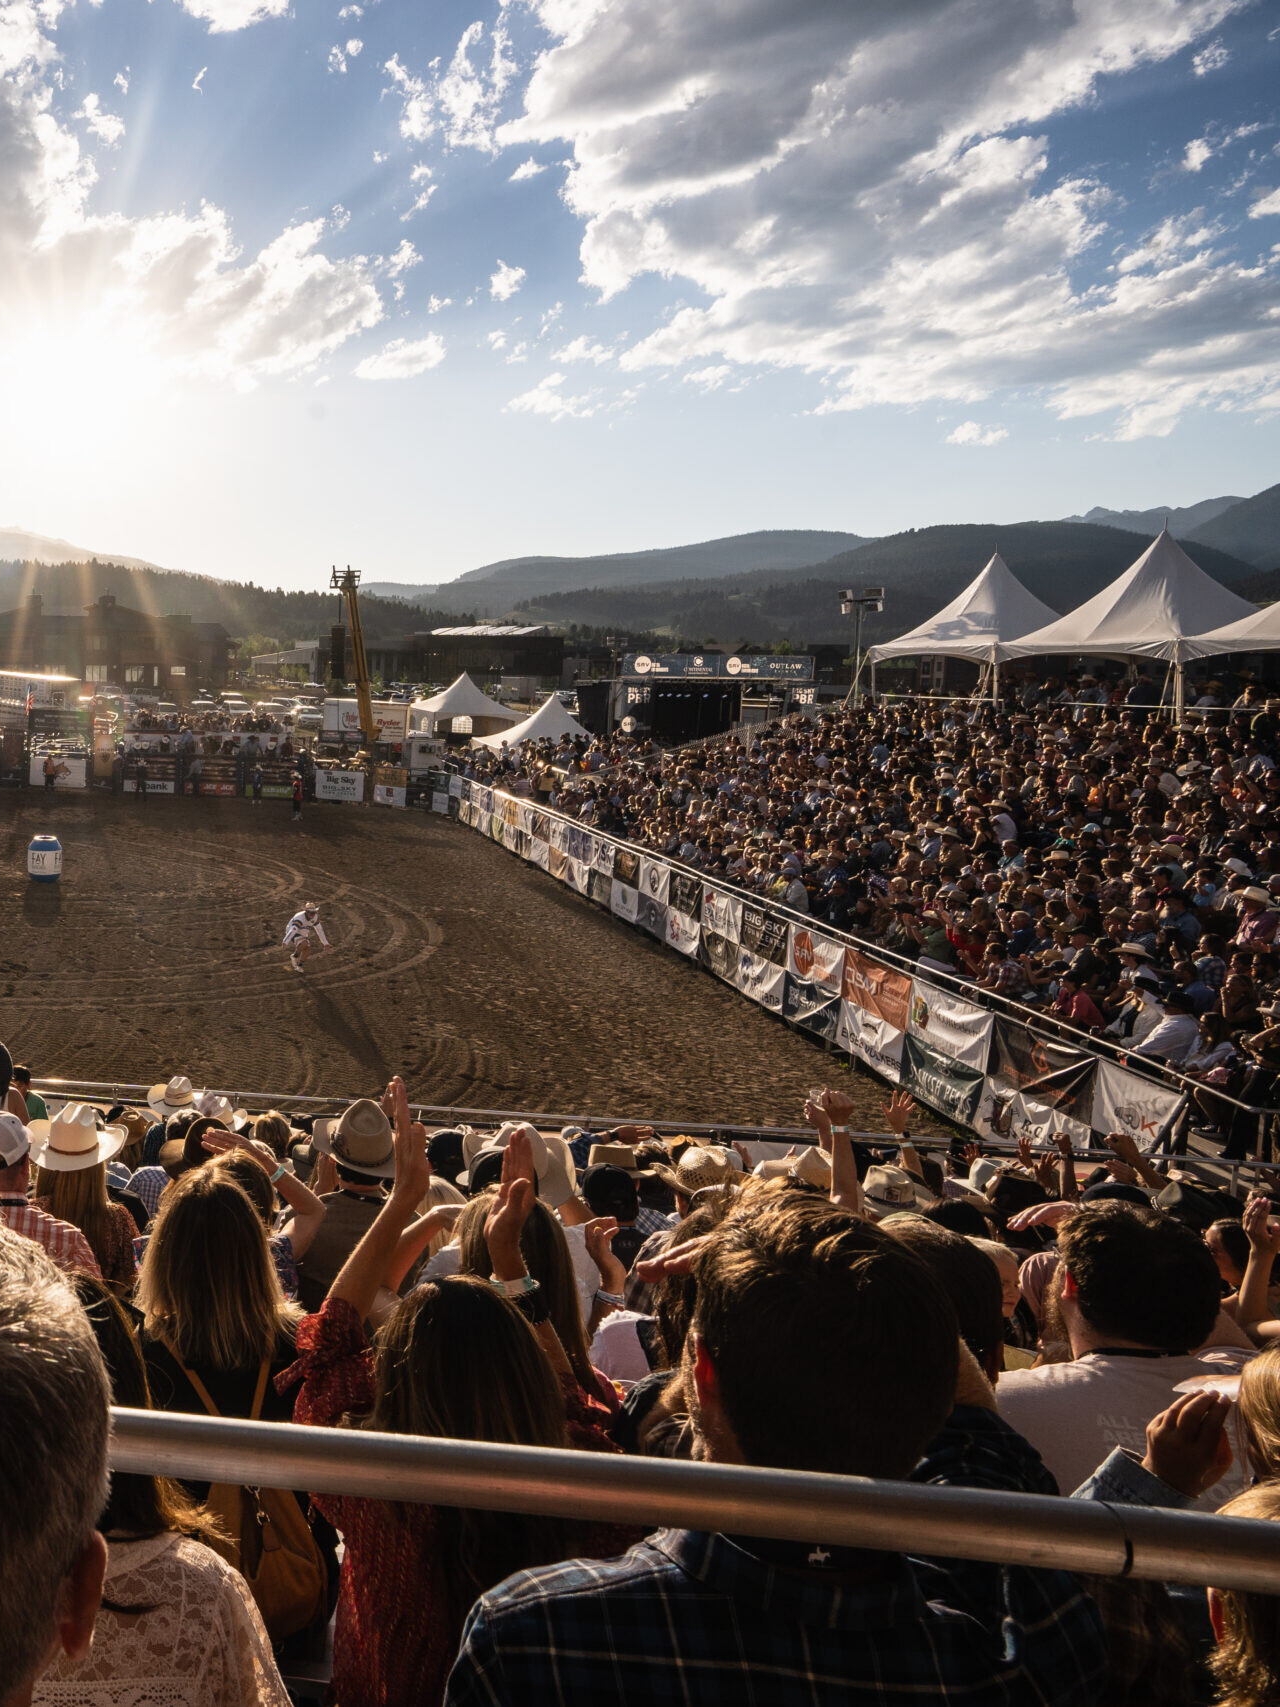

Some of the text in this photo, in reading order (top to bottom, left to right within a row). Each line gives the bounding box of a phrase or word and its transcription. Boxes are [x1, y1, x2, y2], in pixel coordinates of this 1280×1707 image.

[770, 662, 803, 670] OUTLAW
[628, 693, 651, 704] PBR
[791, 694, 815, 704] PBR
[376, 718, 401, 727] Ryder
[326, 775, 340, 785] Big
[744, 910, 763, 926] BIG
